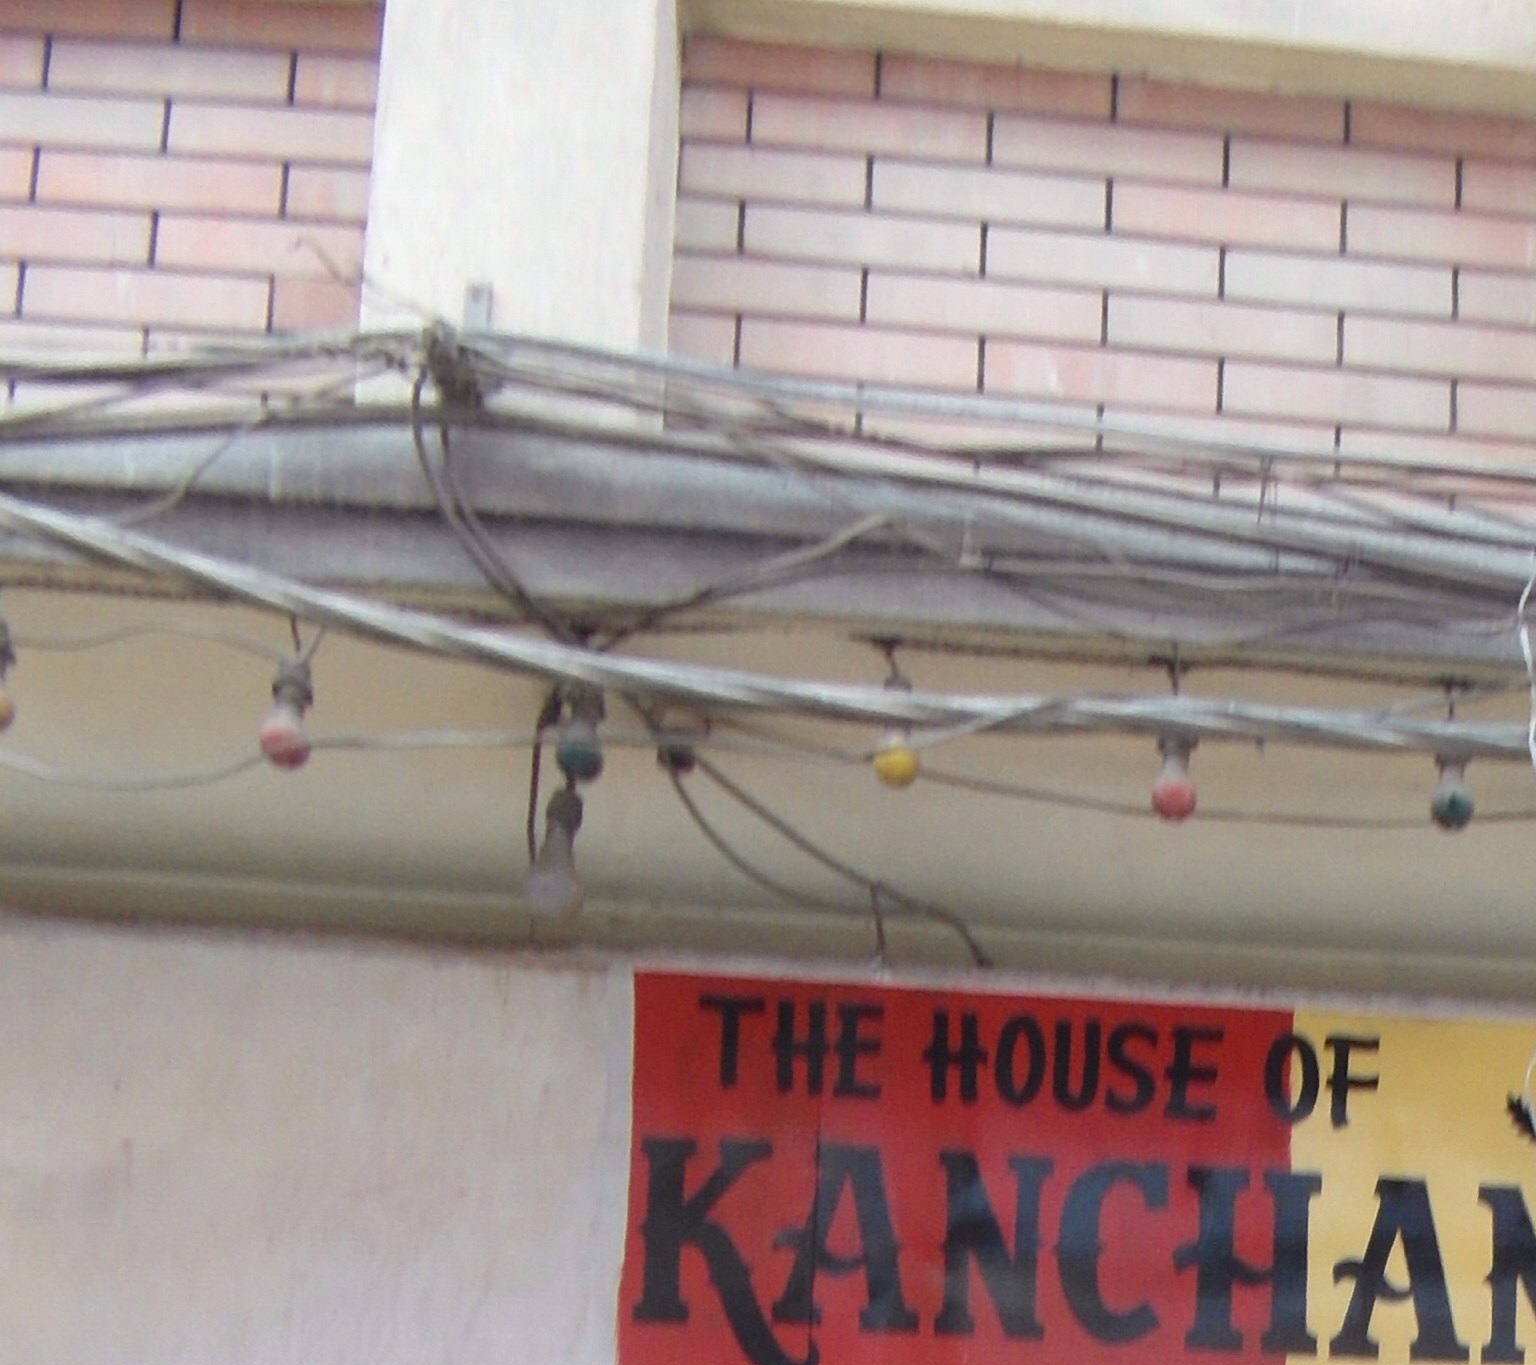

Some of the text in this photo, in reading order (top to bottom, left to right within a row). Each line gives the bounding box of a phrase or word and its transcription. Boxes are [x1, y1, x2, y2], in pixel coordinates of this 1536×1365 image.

[700, 993, 884, 1099] THE
[923, 1009, 1225, 1122] HOUSE
[1263, 1033, 1381, 1130] OF
